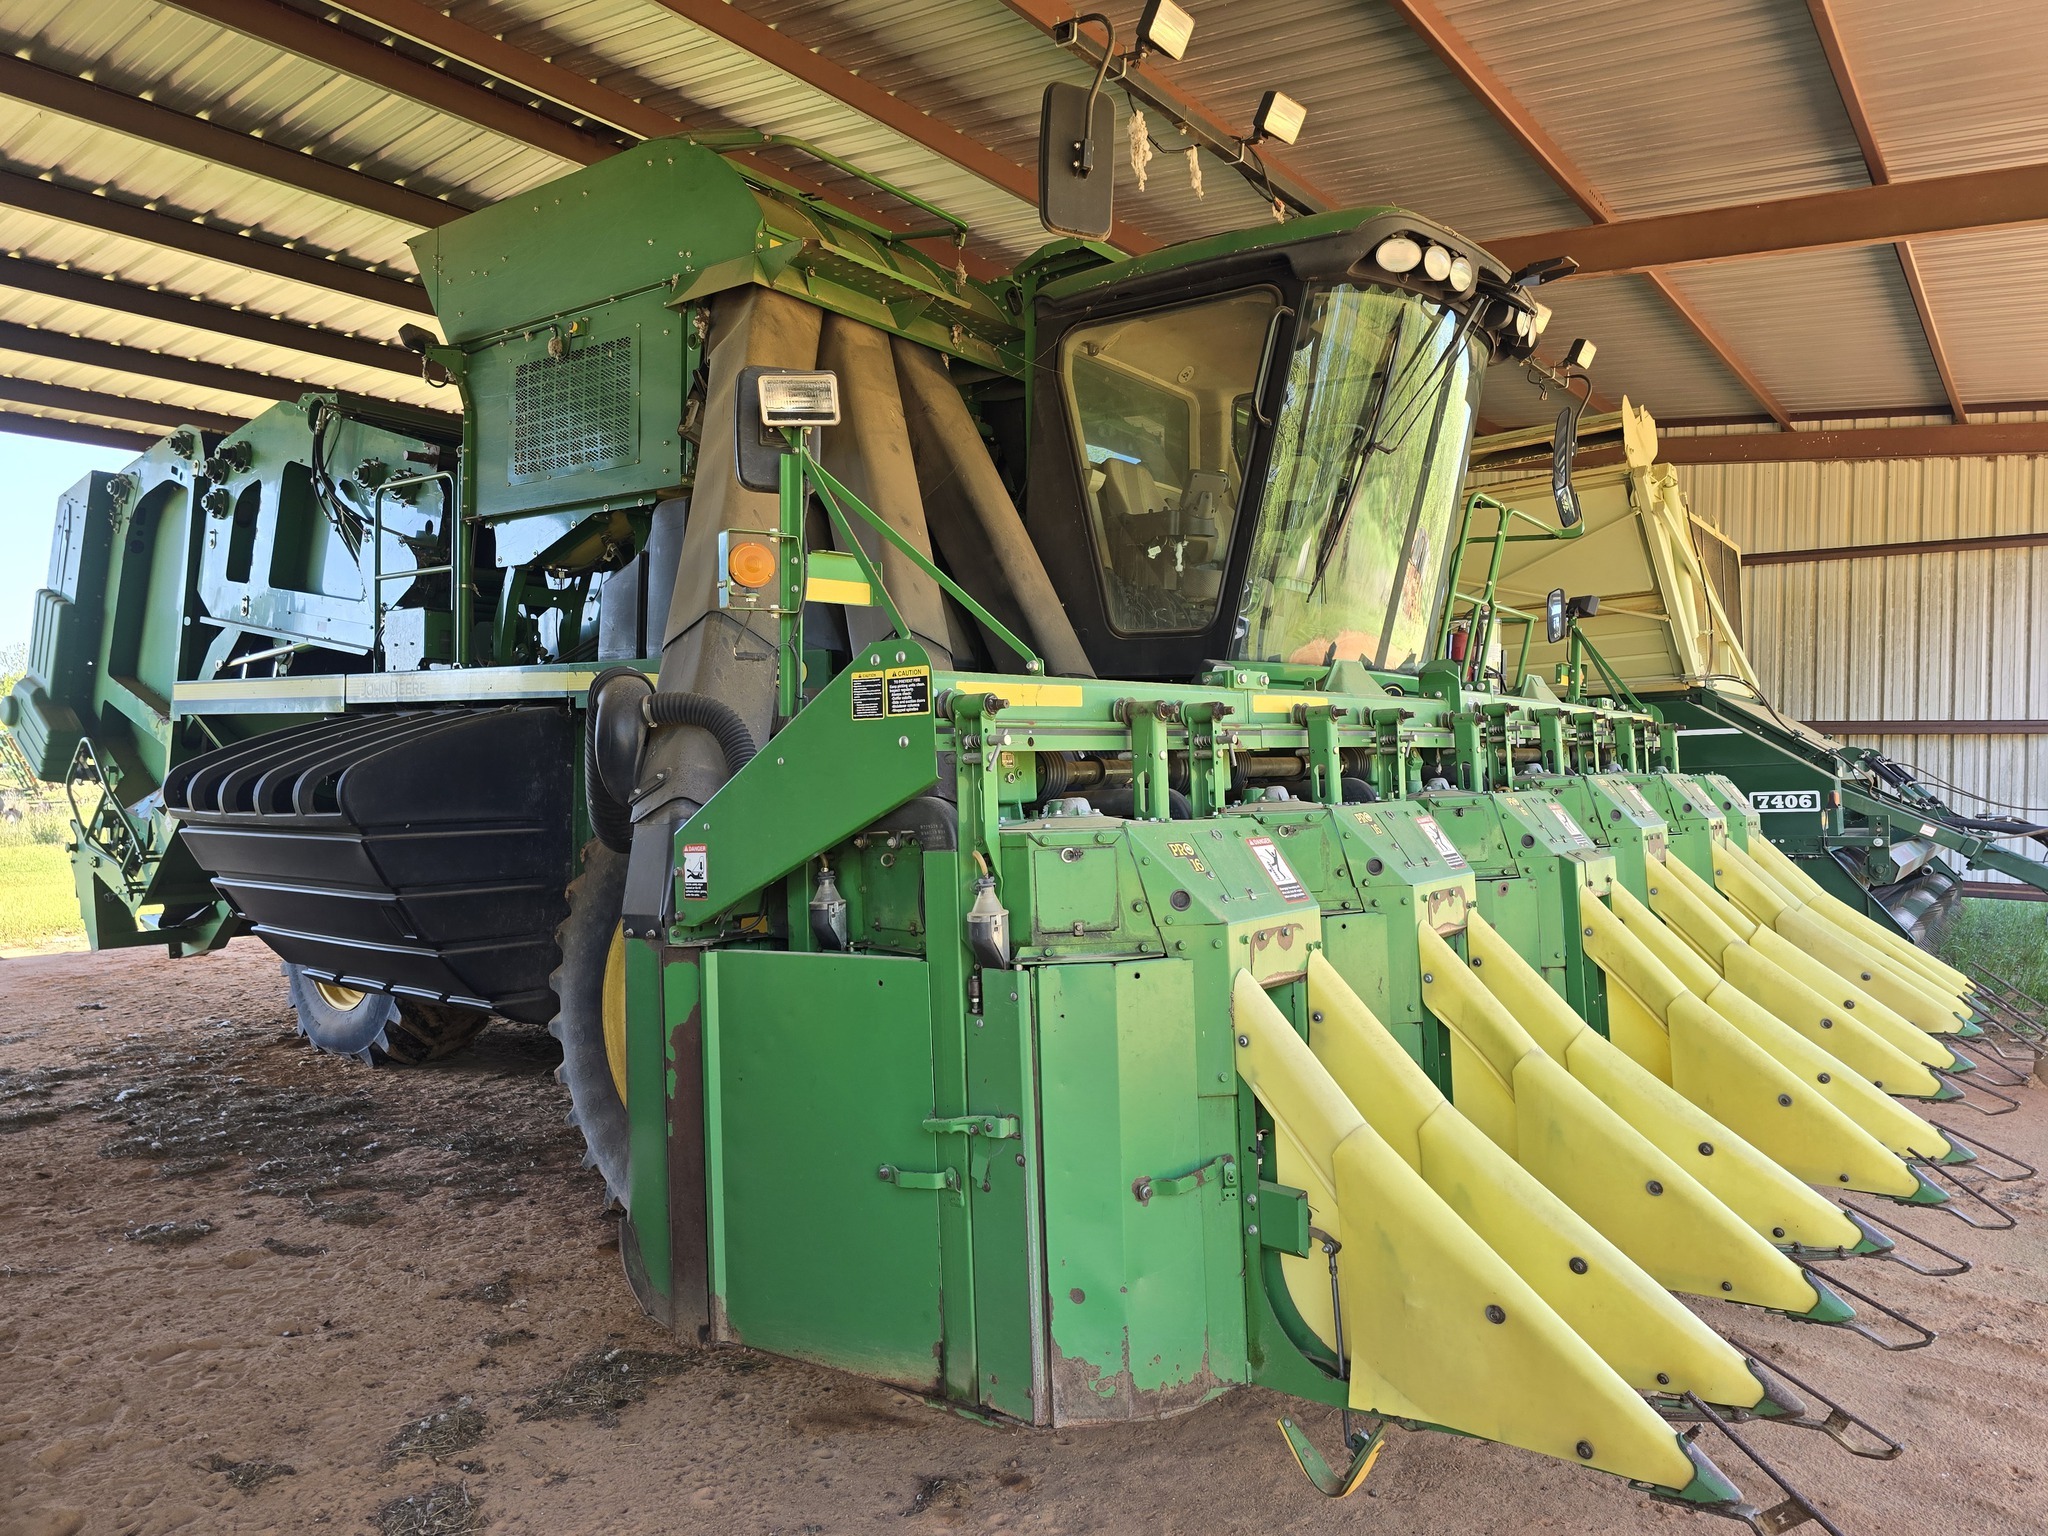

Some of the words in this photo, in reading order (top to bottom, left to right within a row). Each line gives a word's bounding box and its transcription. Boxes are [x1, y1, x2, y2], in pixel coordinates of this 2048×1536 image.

[898, 669, 922, 677] CAUTION
[361, 681, 388, 698] JOHN
[390, 680, 426, 697] DEERE
[1756, 794, 1812, 809] 7406
[1168, 843, 1195, 856] PRO
[1190, 858, 1205, 871] 16
